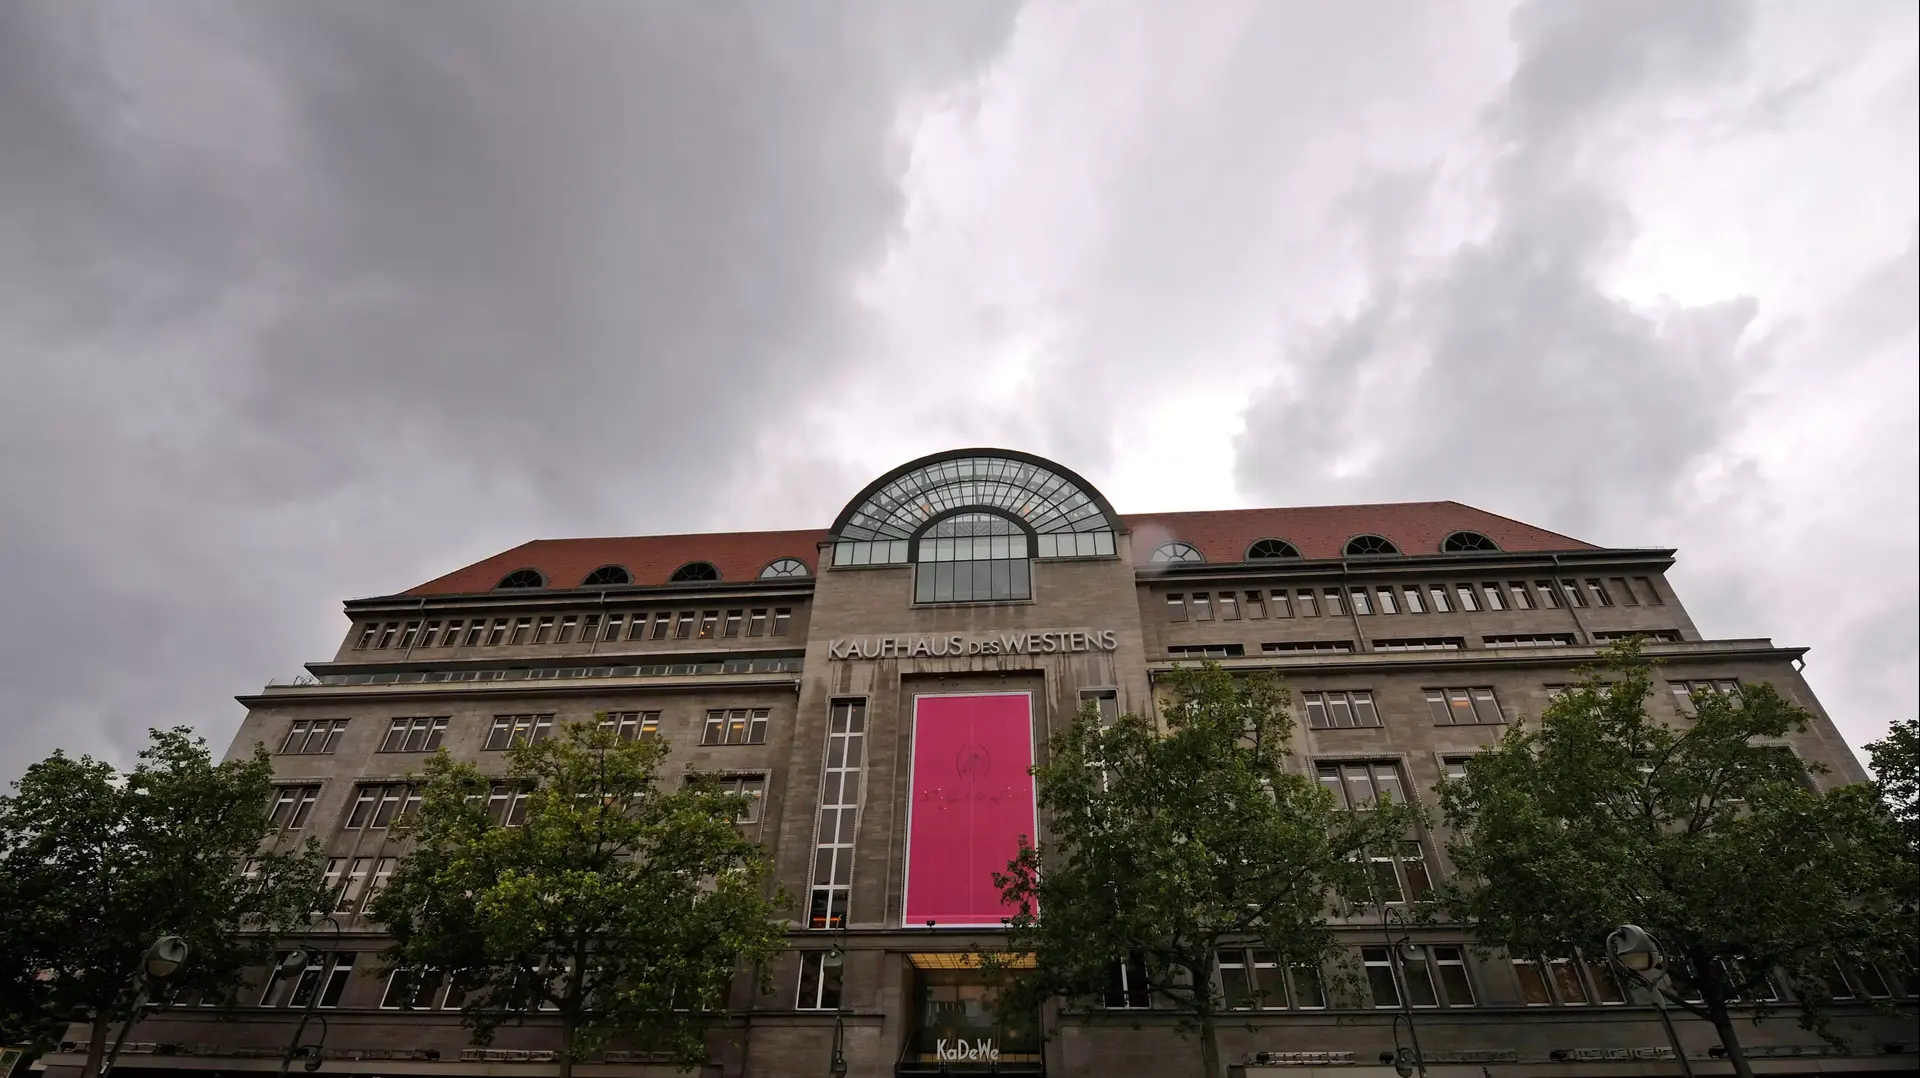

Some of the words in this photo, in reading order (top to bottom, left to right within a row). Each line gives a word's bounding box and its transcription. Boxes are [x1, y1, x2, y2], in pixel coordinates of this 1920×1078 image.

[828, 636, 963, 659] KAUFHAUS
[968, 641, 999, 655] DES
[1000, 630, 1118, 653] WESTENS
[936, 1038, 1000, 1061] KaDeWe
